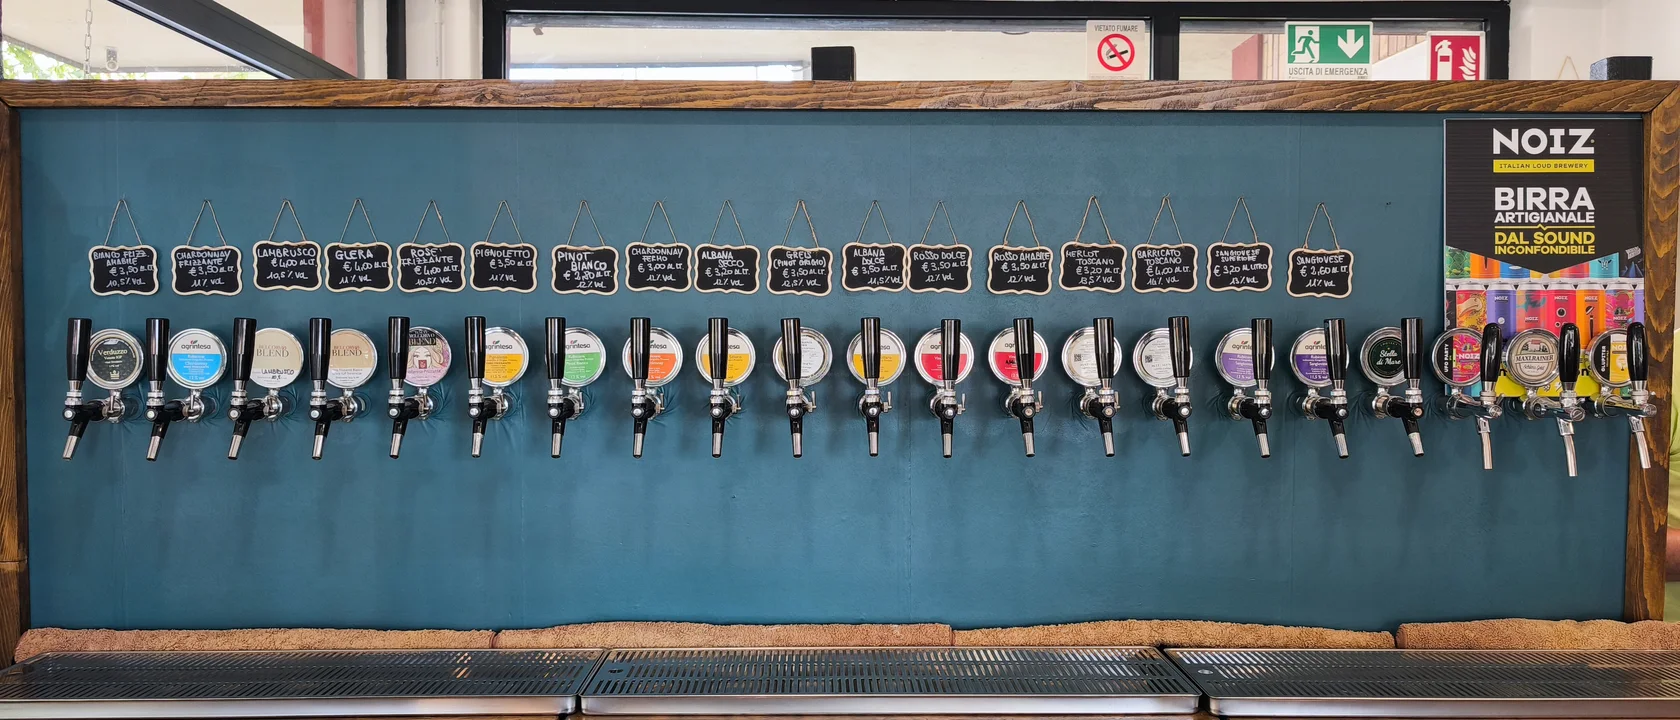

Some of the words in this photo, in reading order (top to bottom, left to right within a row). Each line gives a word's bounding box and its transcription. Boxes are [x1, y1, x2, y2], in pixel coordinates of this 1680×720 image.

[1288, 67, 1313, 76] USCITA
[1315, 67, 1323, 76] DI
[1325, 67, 1368, 76] EMERGENZA
[1493, 128, 1595, 155] NOIZ
[1494, 187, 1595, 211] BIRRA
[1493, 211, 1594, 223] ARTIGIANALE
[1494, 232, 1530, 245] DAL
[1532, 232, 1595, 245] SOUND
[257, 249, 316, 258] LAMBRUSCO
[335, 249, 373, 260] GLERA
[475, 249, 530, 259] PIGNOLETTO
[631, 248, 683, 259] CHARDONNAY
[853, 249, 886, 258] ALBANA
[1066, 250, 1100, 258] MERLOT
[1137, 249, 1181, 259] BARRICATO
[1215, 249, 1261, 257] SANGIOVESE
[1494, 245, 1595, 255] INCONFONDIBILE
[93, 251, 121, 260] BIANCO
[176, 250, 231, 262] CHARDONNAY
[557, 251, 592, 263] PINOT
[701, 251, 733, 261] ALBANA
[913, 252, 940, 261] ROSSO
[941, 251, 967, 260] DOLCE
[994, 252, 1019, 262] ROSSO
[1019, 251, 1050, 262] AMABILE
[1296, 255, 1345, 266] SANGIOVESE
[106, 257, 138, 267] AMABILE
[178, 260, 223, 269] FRIZZANTE
[271, 258, 277, 268] €
[279, 259, 298, 269] 4,00
[400, 256, 454, 267] FRIZZANTE
[489, 259, 498, 270] €
[498, 259, 516, 269] 3,50
[570, 260, 607, 272] BIANCO
[718, 260, 744, 269] SECCO
[861, 258, 885, 266] DOLCE
[1075, 258, 1114, 266] TOSCANO
[1146, 257, 1182, 266] TOSCANO
[109, 267, 118, 276] €
[120, 266, 139, 276] 3,50
[188, 267, 198, 276] €
[198, 266, 219, 275] 3,50
[342, 261, 352, 273] €
[354, 261, 373, 272] 4,00
[413, 265, 422, 276] €
[423, 266, 441, 276] 4,00
[638, 263, 645, 273] €
[851, 266, 859, 277] €
[861, 266, 881, 276] 3,50
[921, 262, 930, 273] €
[931, 261, 951, 271] 3,50
[1001, 262, 1009, 273] €
[1011, 262, 1031, 272] 3,50
[1075, 266, 1083, 276] €
[1146, 265, 1154, 277] €
[1155, 266, 1174, 276] 4,00
[1213, 265, 1221, 277] €
[1223, 265, 1241, 275] 3,20
[1299, 265, 1308, 277] €
[1310, 266, 1331, 276] 2,60
[563, 271, 571, 281] €
[705, 268, 713, 278] €
[714, 268, 733, 278] 3,20
[783, 269, 791, 279] €
[791, 269, 809, 278] 3,50
[257, 349, 289, 357] BLEND
[1379, 349, 1398, 358] Stella
